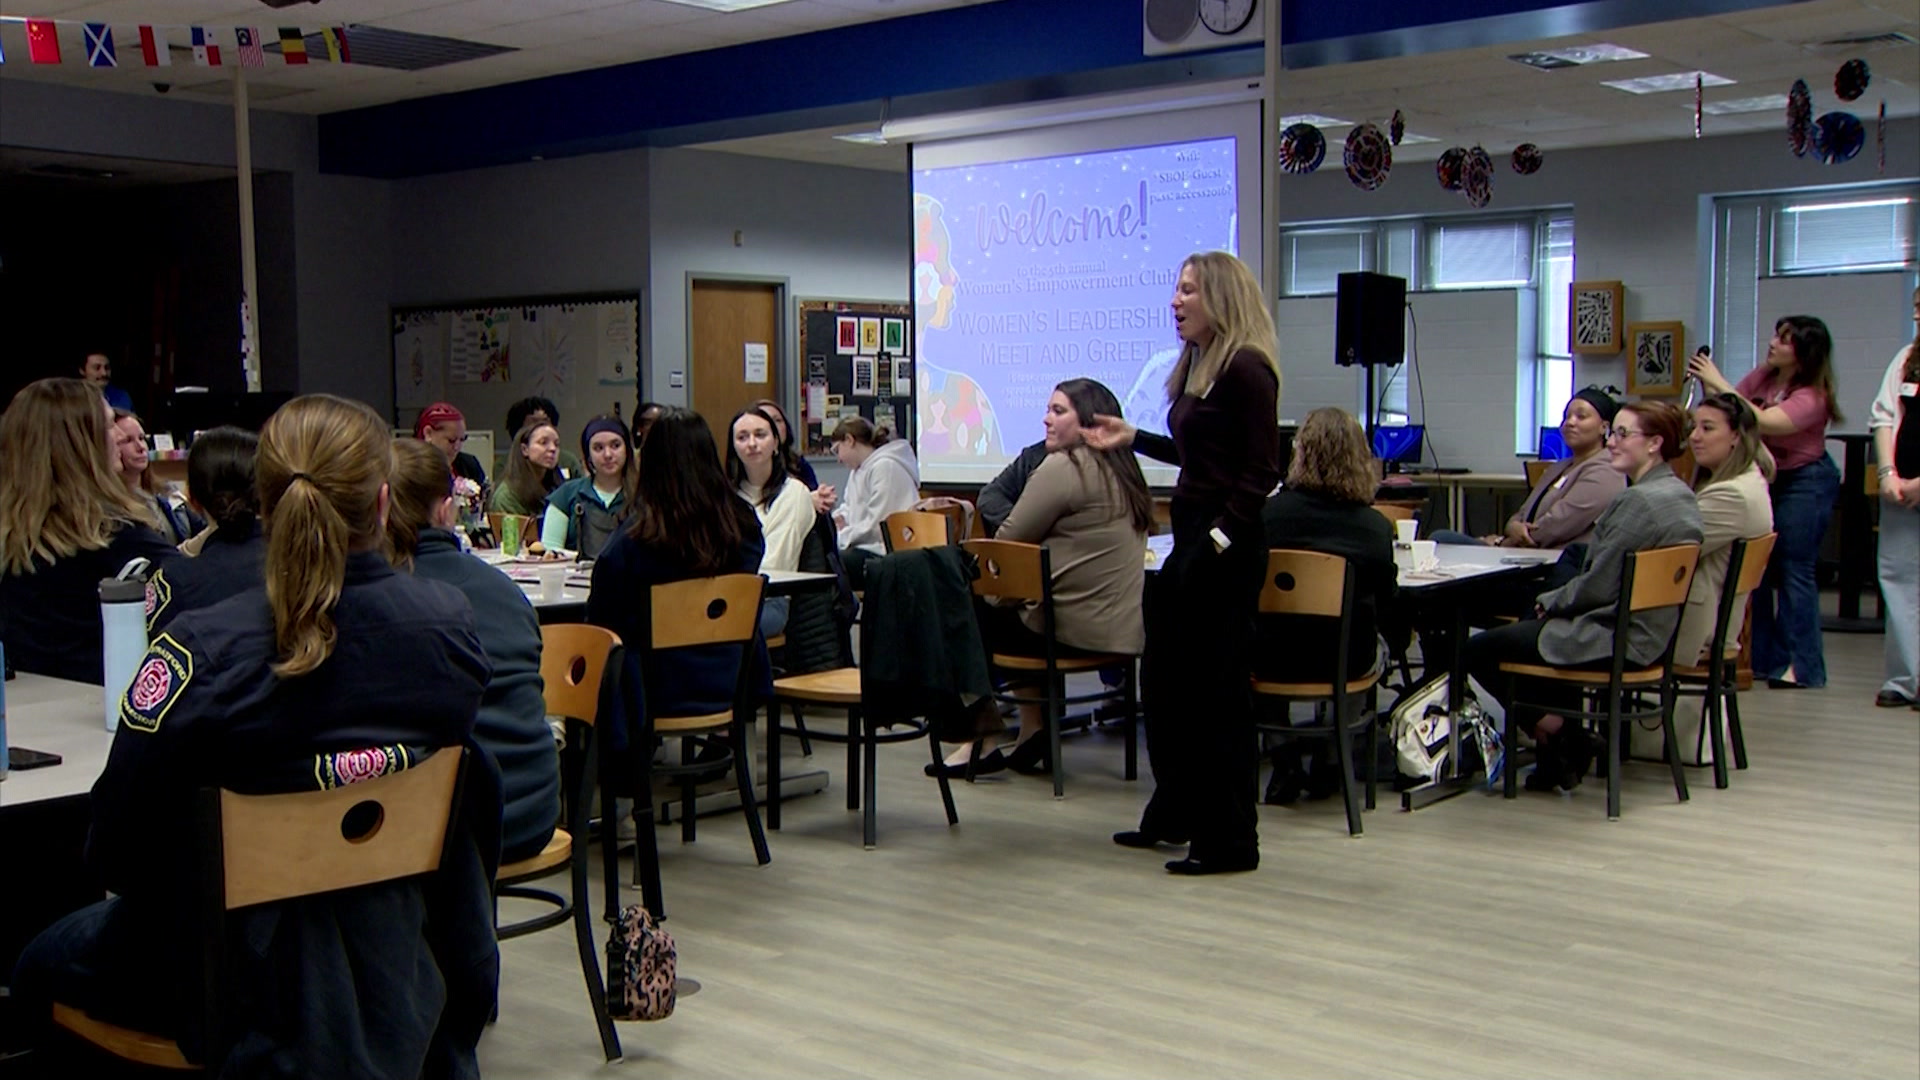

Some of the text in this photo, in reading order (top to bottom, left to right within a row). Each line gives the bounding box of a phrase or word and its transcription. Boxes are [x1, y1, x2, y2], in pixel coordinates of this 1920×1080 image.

[1016, 265, 1028, 278] to
[1029, 263, 1048, 277] the
[1068, 259, 1107, 276] annual
[958, 268, 1176, 297] Women's Empowerment Club
[1055, 306, 1174, 332] LEADERSHI
